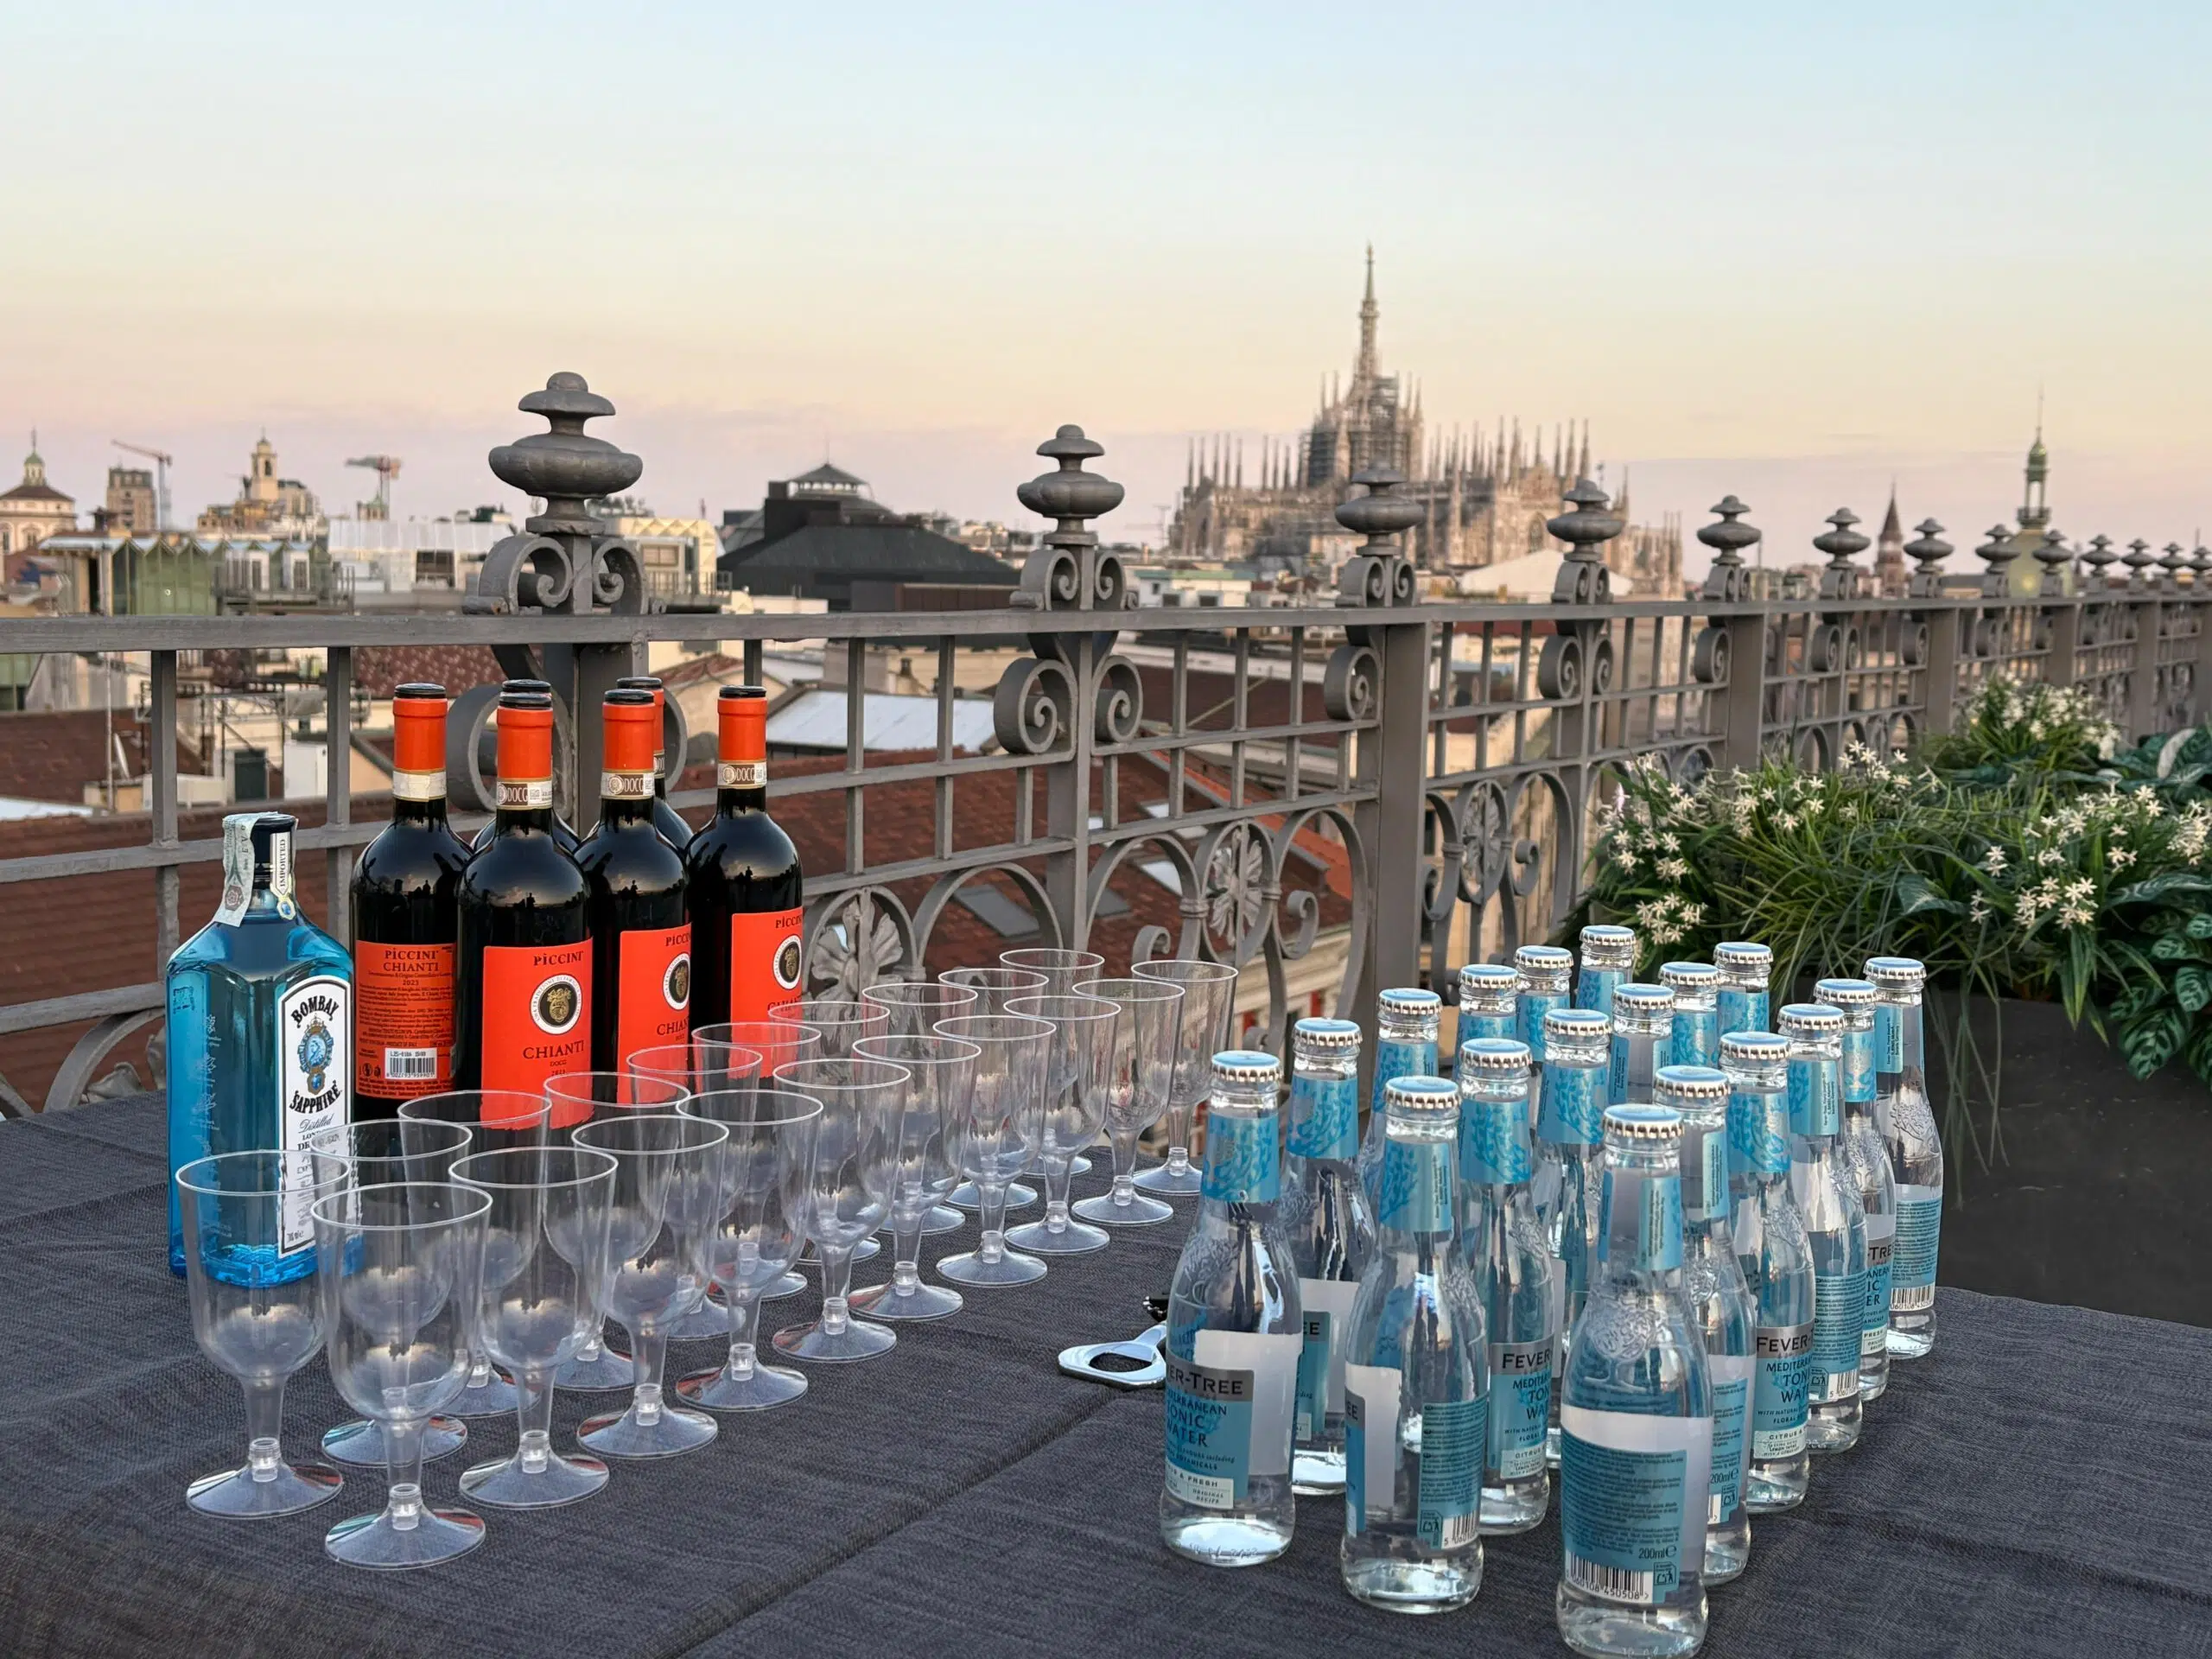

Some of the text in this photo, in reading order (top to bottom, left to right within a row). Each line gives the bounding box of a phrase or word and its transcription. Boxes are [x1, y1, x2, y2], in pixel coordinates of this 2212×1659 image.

[383, 962, 439, 972] CHIANTI
[290, 995, 340, 1028] BOMBAY
[523, 1039, 585, 1059] CHIANTI
[289, 1080, 341, 1114] SAPPHIRE
[299, 1114, 334, 1132] Distilled
[1769, 1430, 1797, 1440] CITRUS
